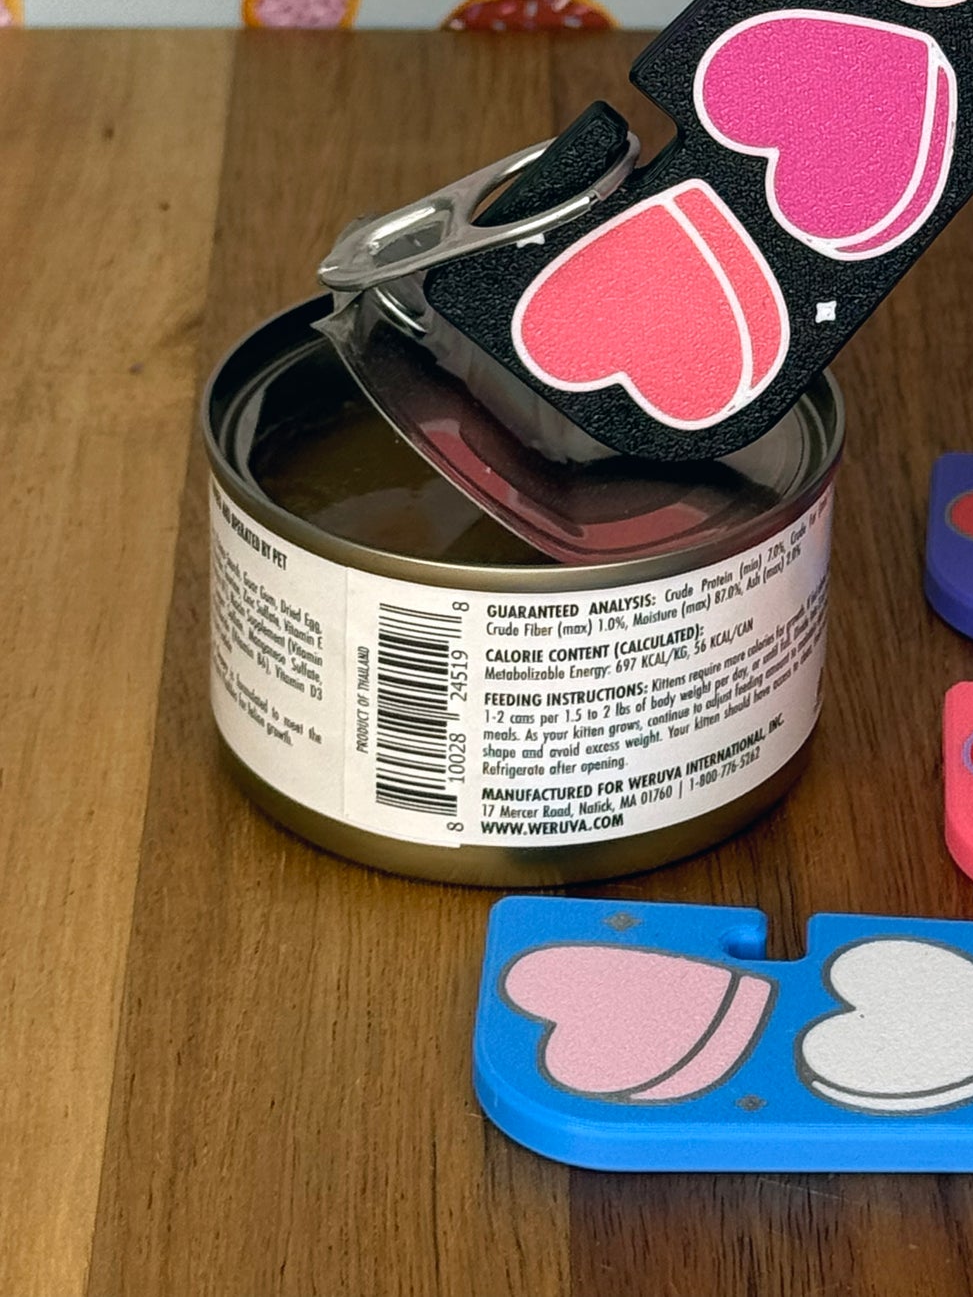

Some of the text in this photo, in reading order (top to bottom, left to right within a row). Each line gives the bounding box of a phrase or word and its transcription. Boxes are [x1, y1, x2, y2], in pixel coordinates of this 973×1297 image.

[261, 539, 272, 560] BY
[273, 548, 287, 571] PET
[280, 599, 301, 622] Dried
[486, 604, 579, 619] GUARANTEED
[588, 594, 656, 616] ANALYSIS:
[665, 583, 694, 602] Crude
[701, 571, 733, 592] Protein
[740, 553, 762, 580] (min)
[486, 621, 519, 636] Crude
[524, 622, 553, 637] Fiber
[558, 618, 592, 638] (max)
[598, 616, 628, 632] 1.0%,
[632, 608, 677, 627] Moisture
[681, 593, 711, 619] (max)
[714, 582, 744, 605] 87.0%,
[746, 572, 760, 591] Ash
[763, 556, 784, 583] (max)
[246, 608, 285, 648] Supplement
[287, 637, 323, 667] (Vitamin
[284, 618, 315, 646] Vitamin
[317, 636, 323, 651] E
[484, 617, 754, 681] Metabolizable Energy: 697 KCAL/KG, 56 KCAL/CAN
[485, 623, 705, 663] CALORIE CONTENT (CALCULATED):
[275, 664, 305, 693] Vitamin
[309, 684, 323, 701] D3
[291, 657, 322, 686] Sulfate,
[484, 692, 543, 706] FEEDING
[546, 682, 648, 706] INSTRUCTIONS:
[651, 674, 686, 693] Kittens
[688, 662, 722, 685] require
[724, 651, 746, 669] more
[271, 706, 280, 722] to
[283, 716, 304, 736] meet
[308, 726, 323, 745] the
[356, 646, 369, 754] PRODUCT OF THAILAND
[447, 602, 470, 832] 8 10028 24519 8
[482, 743, 516, 761] shape
[522, 744, 544, 758] and
[549, 742, 580, 758] avoid
[585, 741, 620, 755] excess
[625, 730, 663, 749] weight.
[668, 724, 690, 739] Your
[694, 712, 720, 731] kitten
[724, 692, 751, 719] should
[753, 686, 770, 703] have
[483, 727, 520, 741] meals.
[525, 728, 538, 741] As
[543, 730, 569, 744] your
[573, 725, 604, 739] kitten
[608, 720, 643, 738] grows,
[647, 708, 690, 727] continue
[693, 703, 703, 715] to
[705, 687, 732, 709] adjust
[735, 673, 763, 697] feeding
[485, 709, 504, 723] 1-2
[510, 713, 535, 724] cans
[540, 713, 559, 727] per
[565, 708, 582, 722] 1.5
[587, 709, 598, 720] to
[603, 705, 611, 718] 2
[615, 702, 631, 716] lbs
[635, 697, 647, 712] of
[651, 692, 676, 710] body
[680, 681, 712, 701] weight
[714, 675, 730, 693] per
[481, 785, 593, 802] MANUFACTURED
[597, 780, 624, 796] FOR
[628, 766, 682, 791] WERUVA
[686, 728, 766, 776] INTERNATIONAL,
[482, 756, 629, 779] Refrigerate after opening.
[480, 813, 624, 836] WWW.WERUVA.COM
[482, 803, 495, 818] 17
[499, 804, 539, 819] Mercer
[542, 801, 575, 818] Road,
[578, 797, 616, 816] Natick,
[620, 794, 637, 810] MA
[640, 785, 673, 805] 01760
